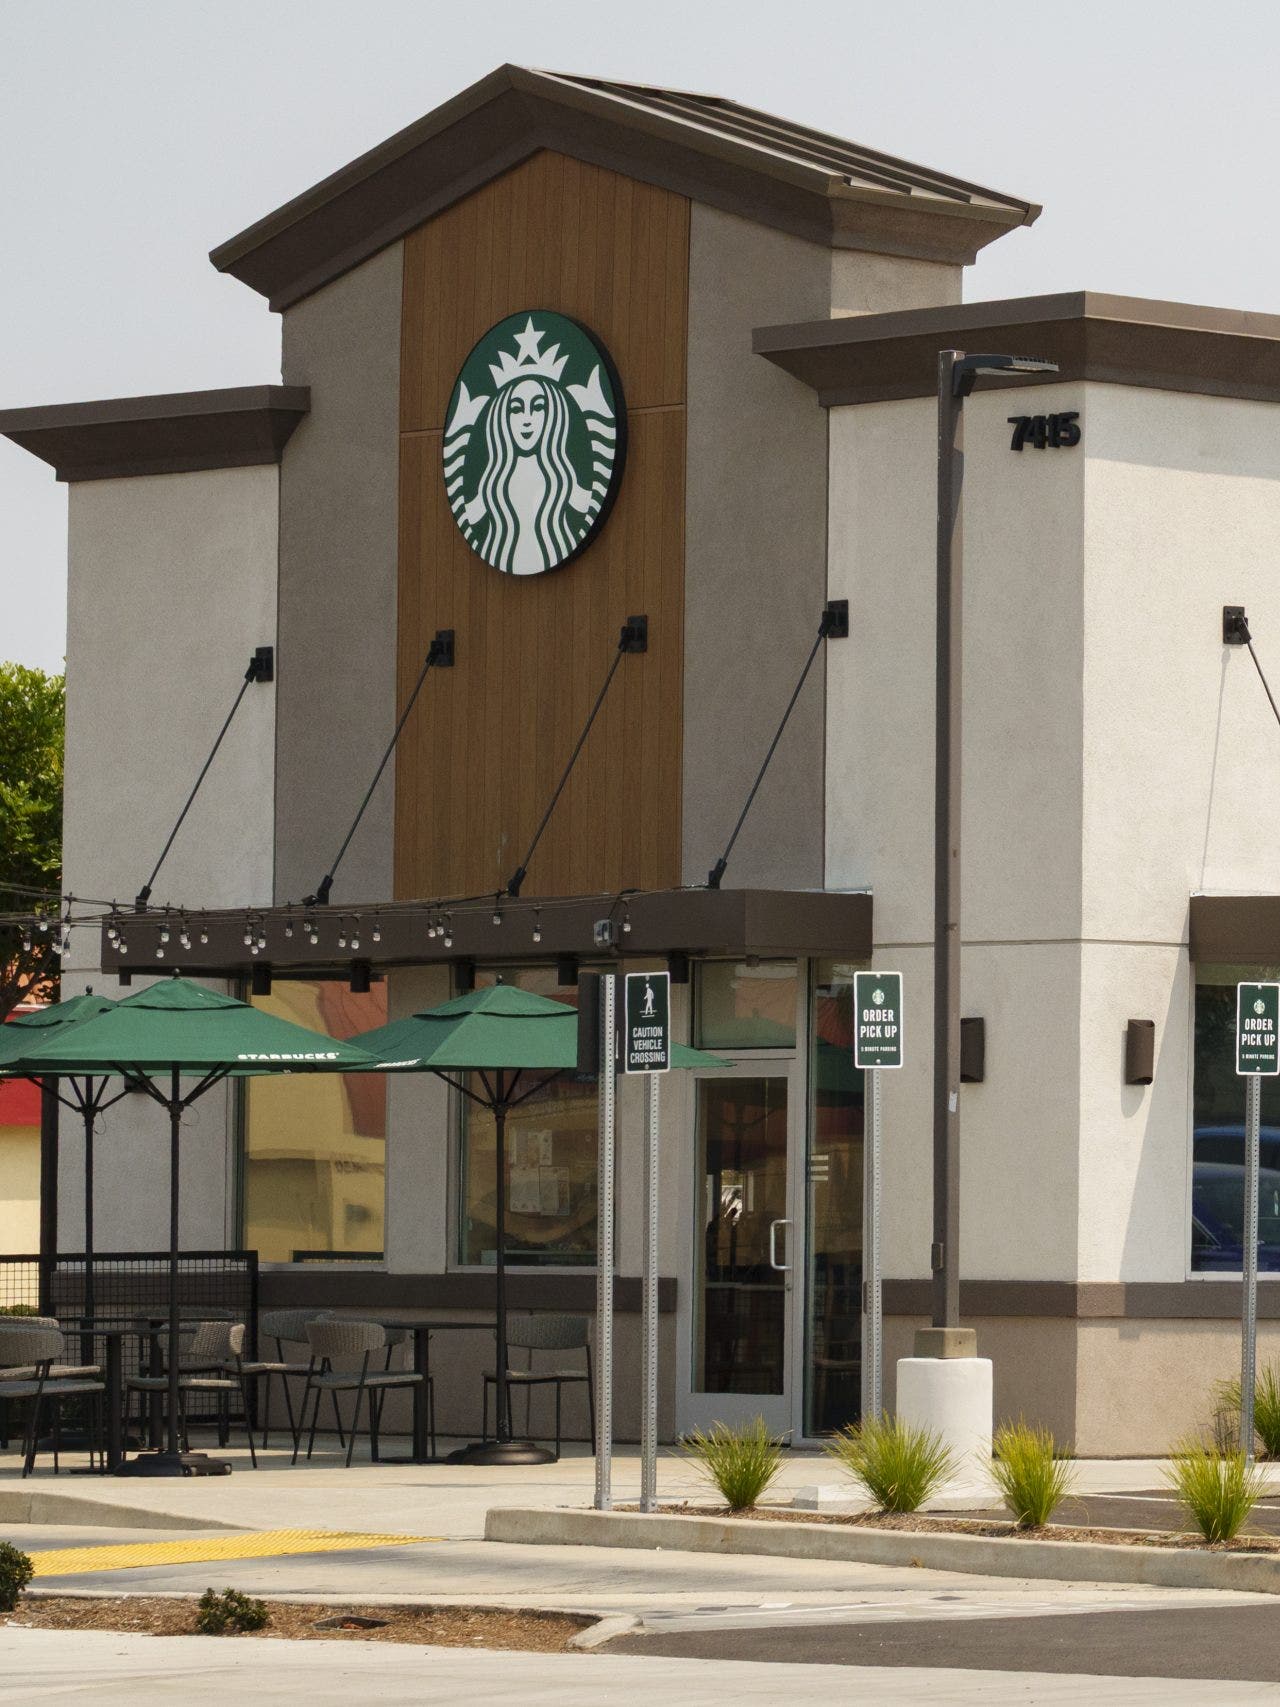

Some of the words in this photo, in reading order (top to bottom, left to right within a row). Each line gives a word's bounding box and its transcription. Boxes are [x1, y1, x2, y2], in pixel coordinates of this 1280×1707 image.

[1007, 411, 1081, 451] 7415
[863, 1009, 894, 1022] ORDER
[1244, 1018, 1273, 1031] ORDER
[632, 1026, 663, 1038] CAUTION
[860, 1025, 882, 1038] PICK
[884, 1025, 898, 1038] UP
[633, 1039, 662, 1051] VEHICLE
[1241, 1033, 1262, 1046] PICK
[1264, 1034, 1276, 1046] UP
[237, 1052, 338, 1060] STARBUCKS
[630, 1051, 666, 1063] CROSSING
